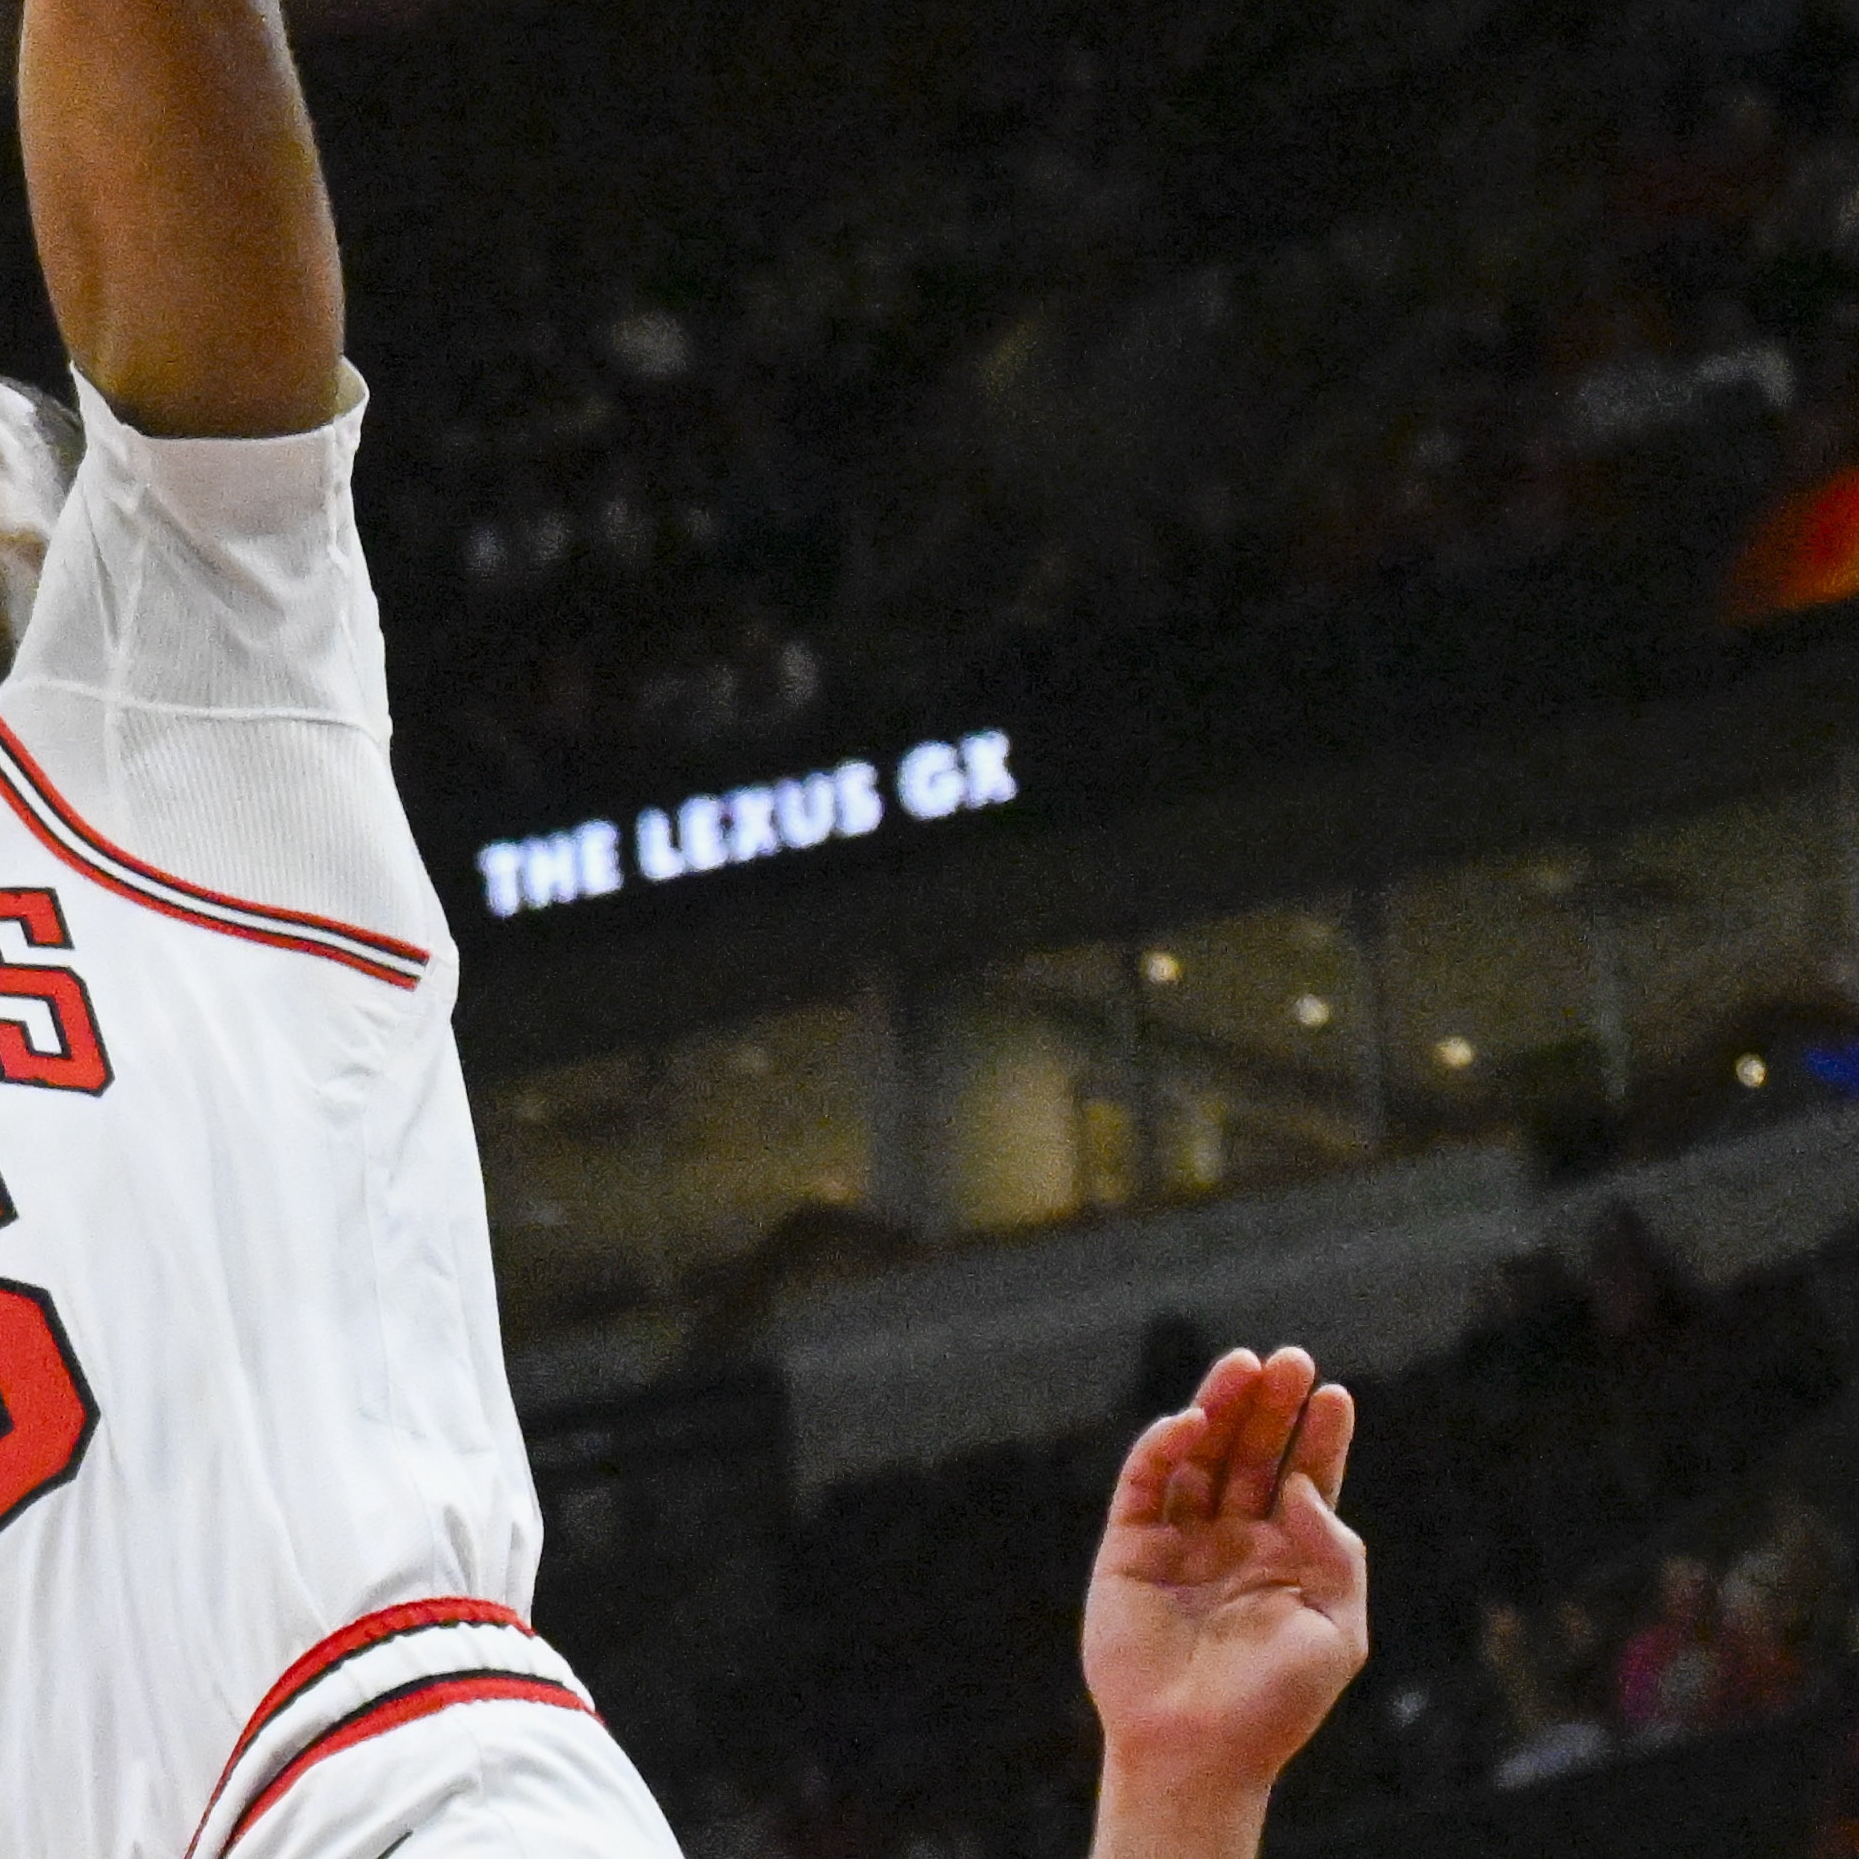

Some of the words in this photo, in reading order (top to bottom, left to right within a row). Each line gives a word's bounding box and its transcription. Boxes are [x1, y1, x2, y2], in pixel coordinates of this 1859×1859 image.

[478, 819, 623, 917] THE
[636, 760, 883, 881] LEXUS
[897, 730, 1017, 820] GX
